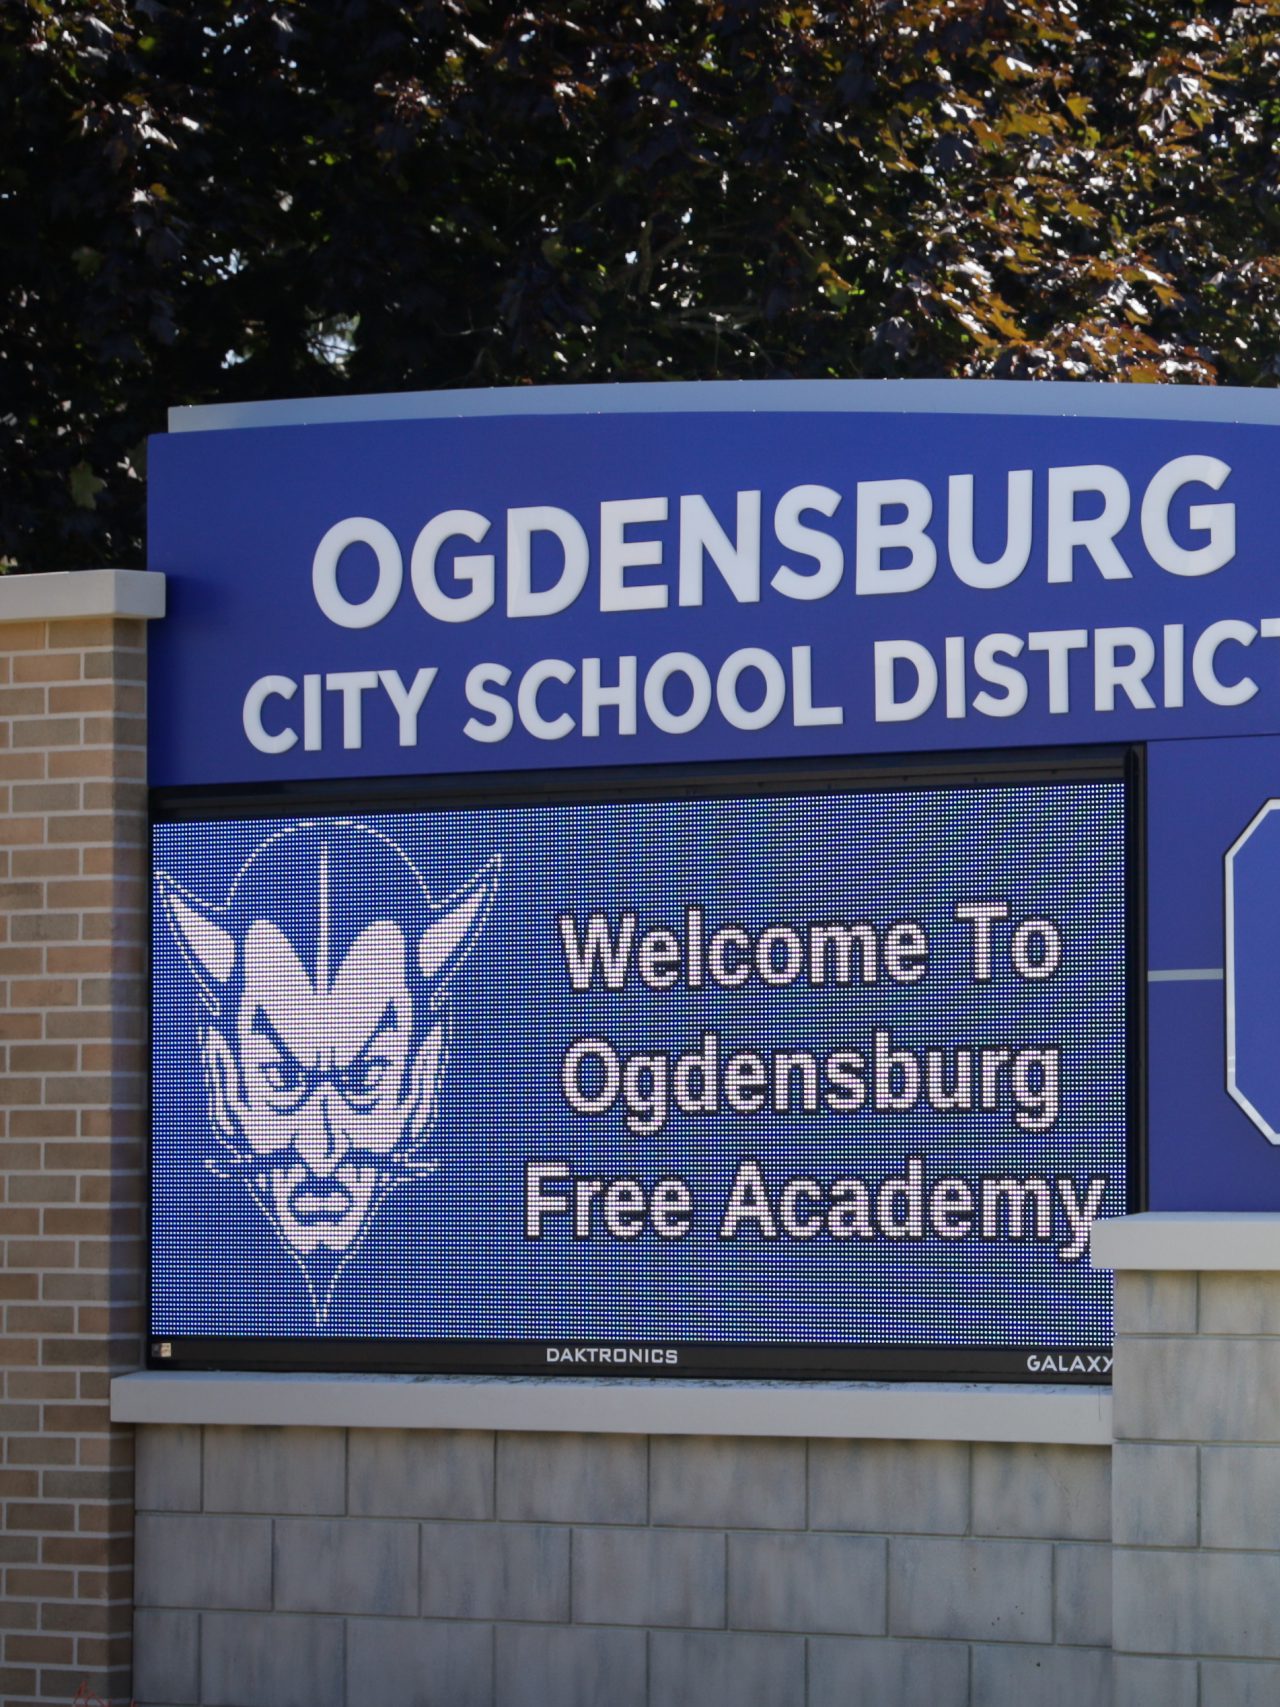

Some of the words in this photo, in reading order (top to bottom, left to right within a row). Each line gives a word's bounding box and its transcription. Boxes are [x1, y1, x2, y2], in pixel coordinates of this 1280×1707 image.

[313, 455, 1236, 628] OGDENSBURG
[242, 667, 437, 754] CITY
[463, 645, 843, 743] SCHOOL
[559, 906, 929, 990] Welcome
[956, 901, 1062, 982] To
[562, 1030, 1061, 1137] Ogdensburg
[525, 1161, 691, 1239] Free
[720, 1158, 1106, 1261] Academy
[546, 1347, 678, 1364] DAKTRONICS
[1026, 1354, 1113, 1373] GALAXY
